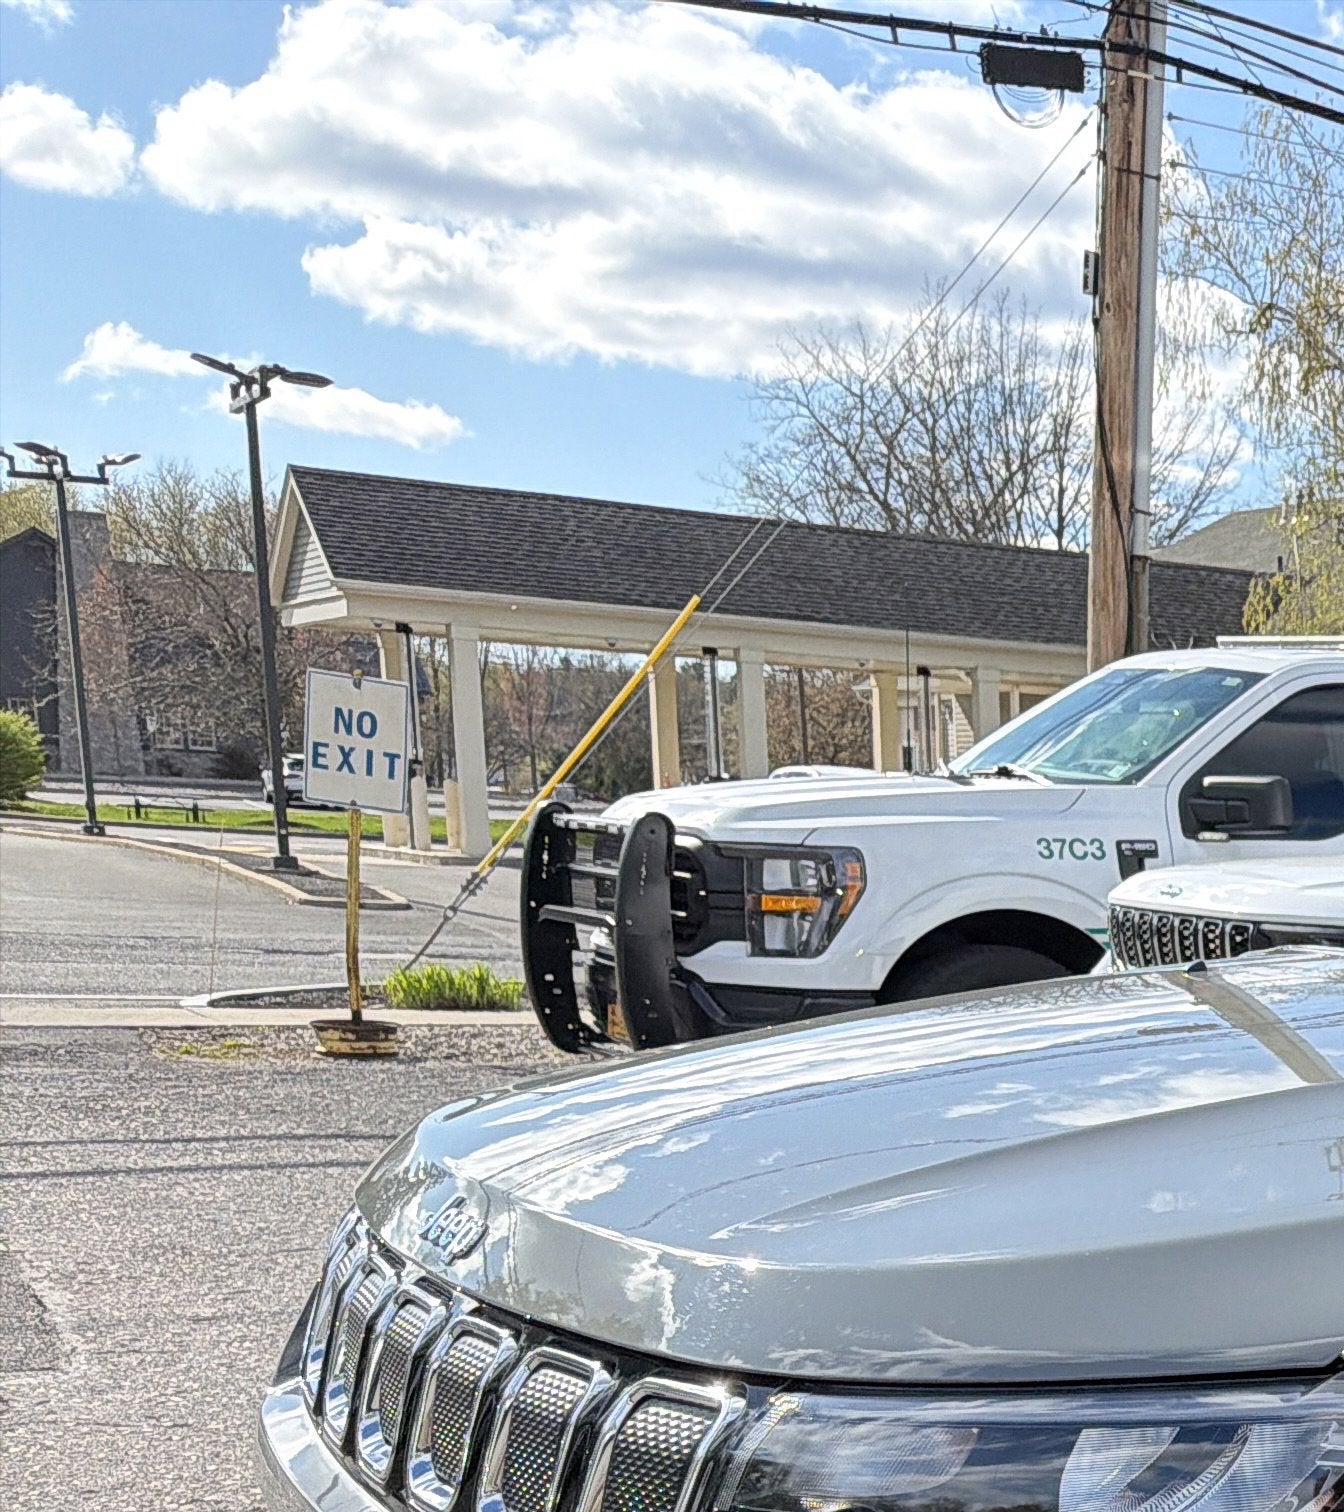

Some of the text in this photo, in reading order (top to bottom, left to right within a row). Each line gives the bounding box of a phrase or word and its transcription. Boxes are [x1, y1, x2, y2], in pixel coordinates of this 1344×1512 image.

[333, 706, 378, 739] NO
[311, 741, 402, 780] EXIT
[1036, 837, 1107, 861] 37C3
[416, 1193, 489, 1267] Jeep
